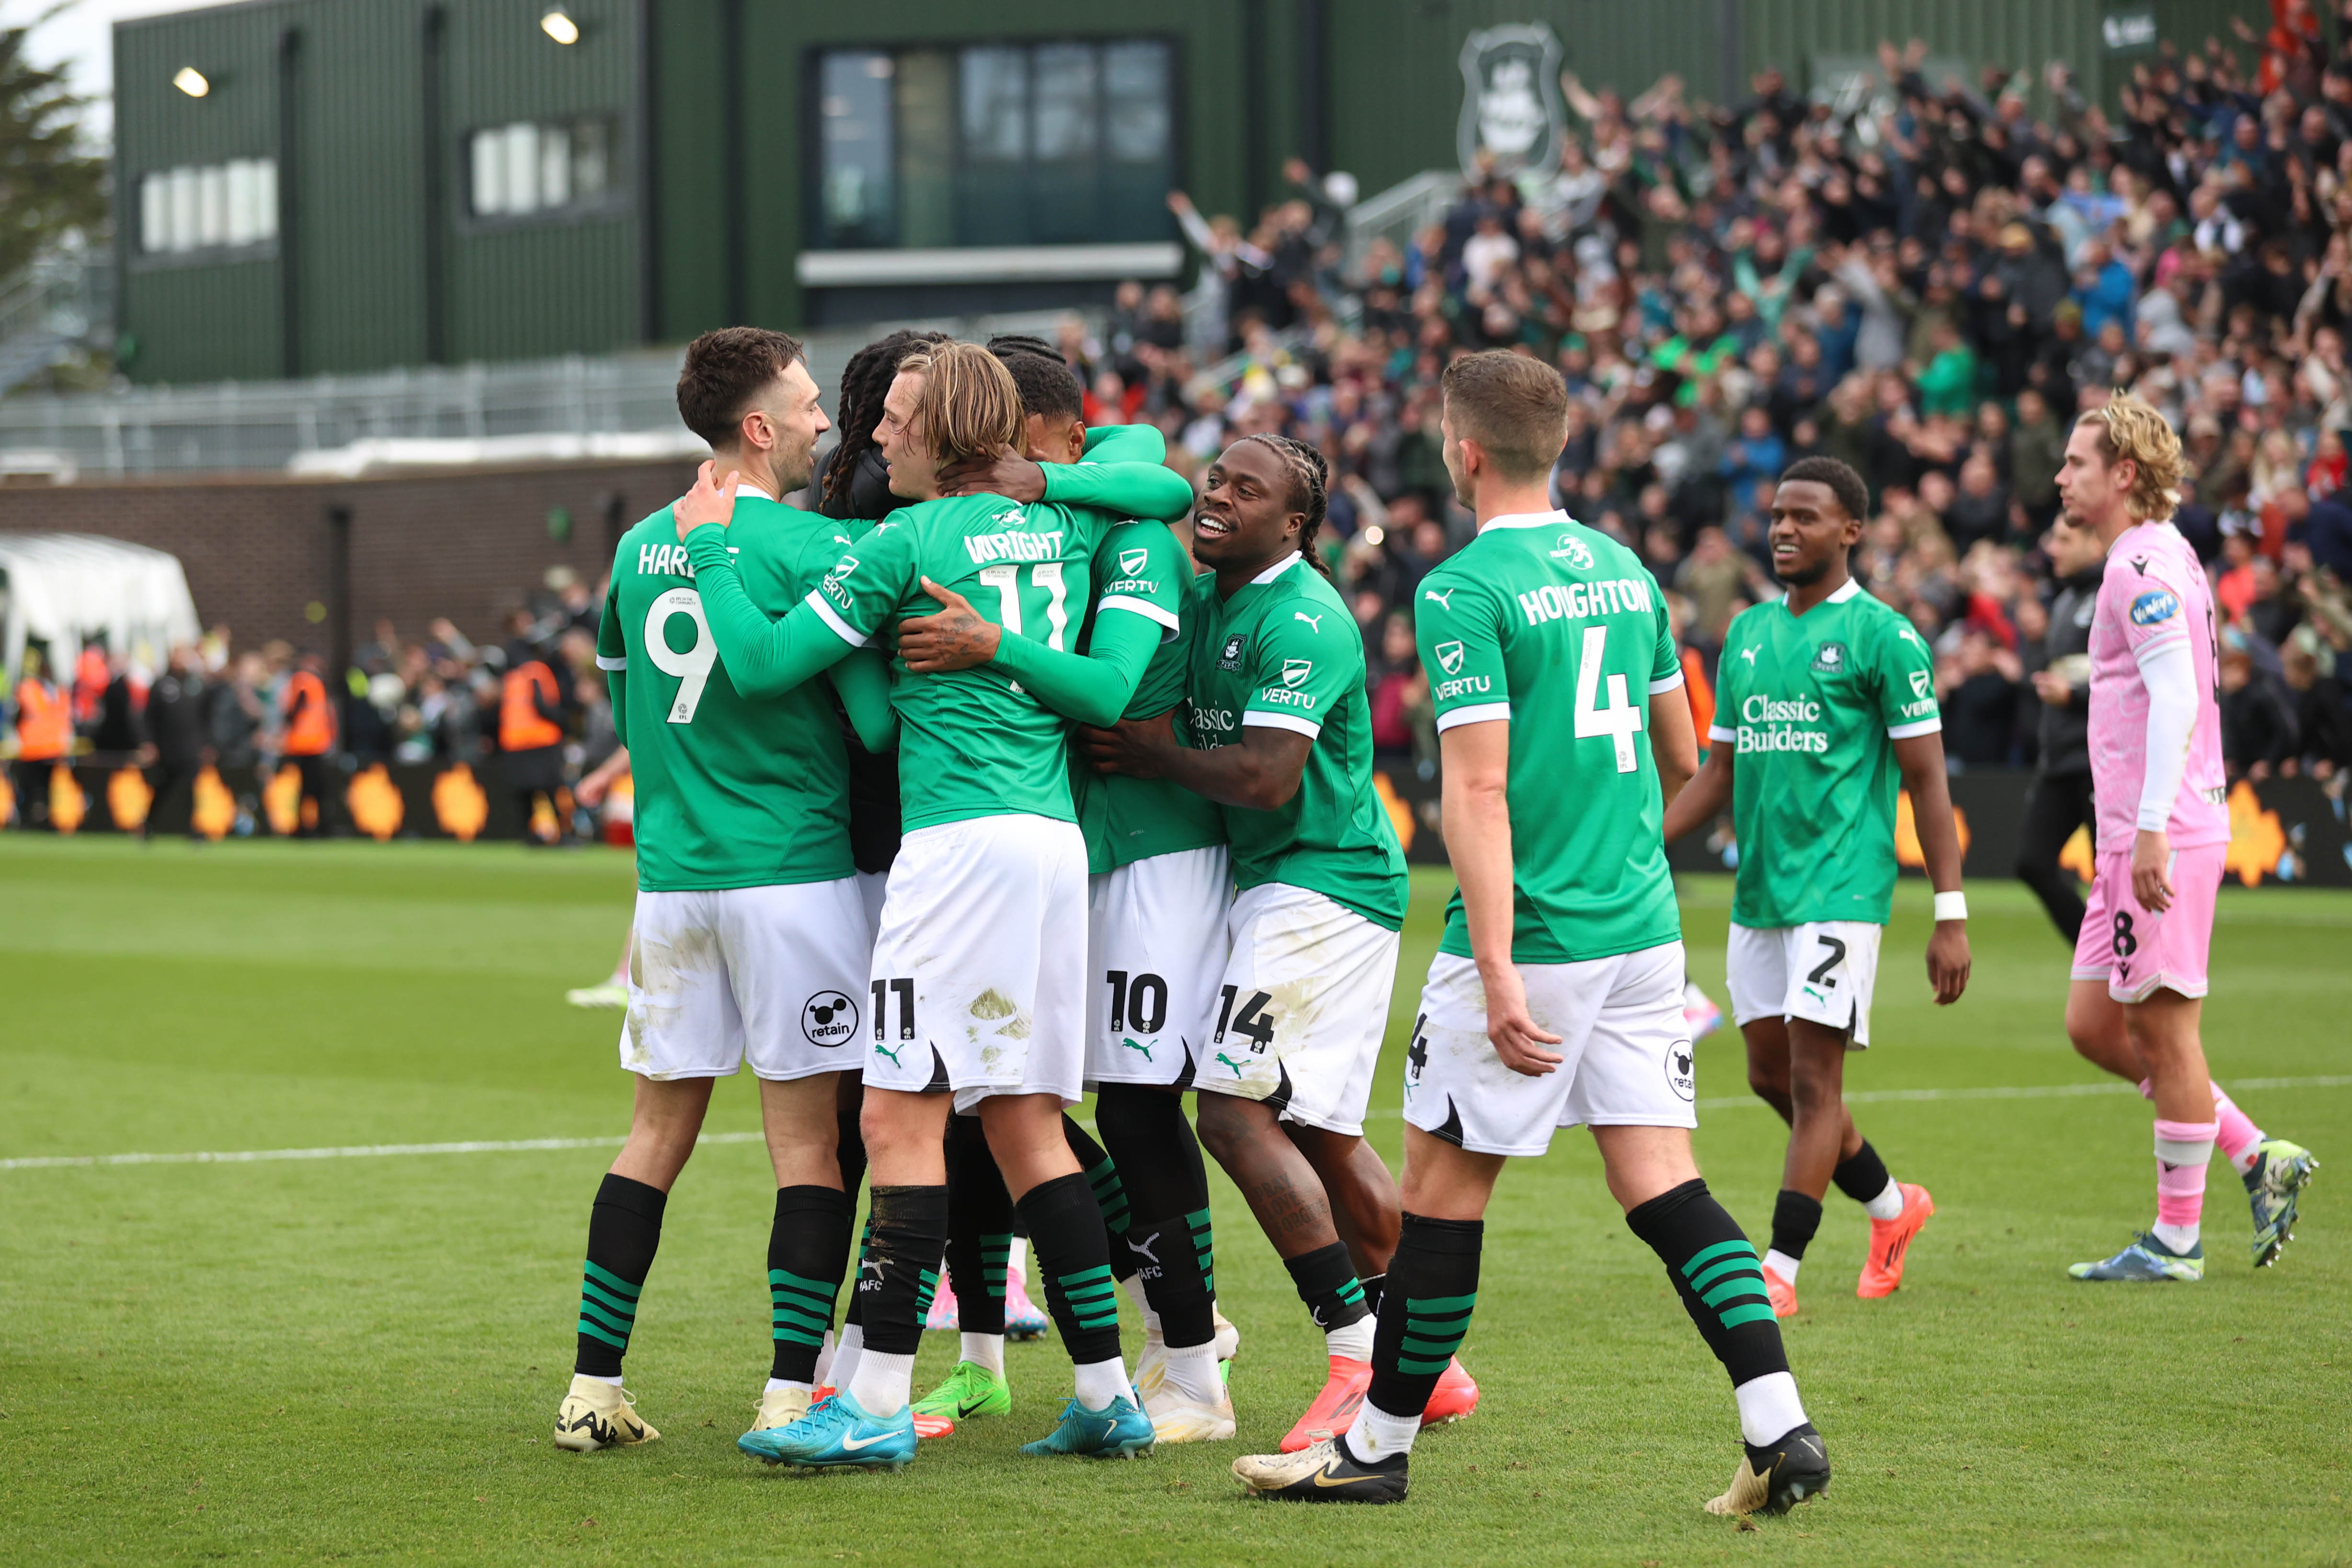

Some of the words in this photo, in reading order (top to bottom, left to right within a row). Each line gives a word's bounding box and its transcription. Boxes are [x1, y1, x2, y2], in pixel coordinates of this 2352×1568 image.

[964, 530, 1063, 564] WRIGHT
[1519, 580, 1651, 626] HOUGHTON
[979, 562, 1067, 693] 11
[644, 587, 719, 724] 9
[1262, 687, 1316, 710] VERTU
[1435, 675, 1491, 701] VERTU
[1575, 625, 1643, 774] 4
[1742, 692, 1820, 724] Classic
[1736, 723, 1828, 754] Builders
[2113, 912, 2136, 957] 8
[1807, 935, 1846, 988] 2
[871, 978, 915, 1040] 11
[1107, 970, 1168, 1033] 10
[1214, 984, 1274, 1054] 14
[812, 1022, 850, 1038] retain
[1408, 1013, 1428, 1079] 4
[1674, 1077, 1692, 1089] reta
